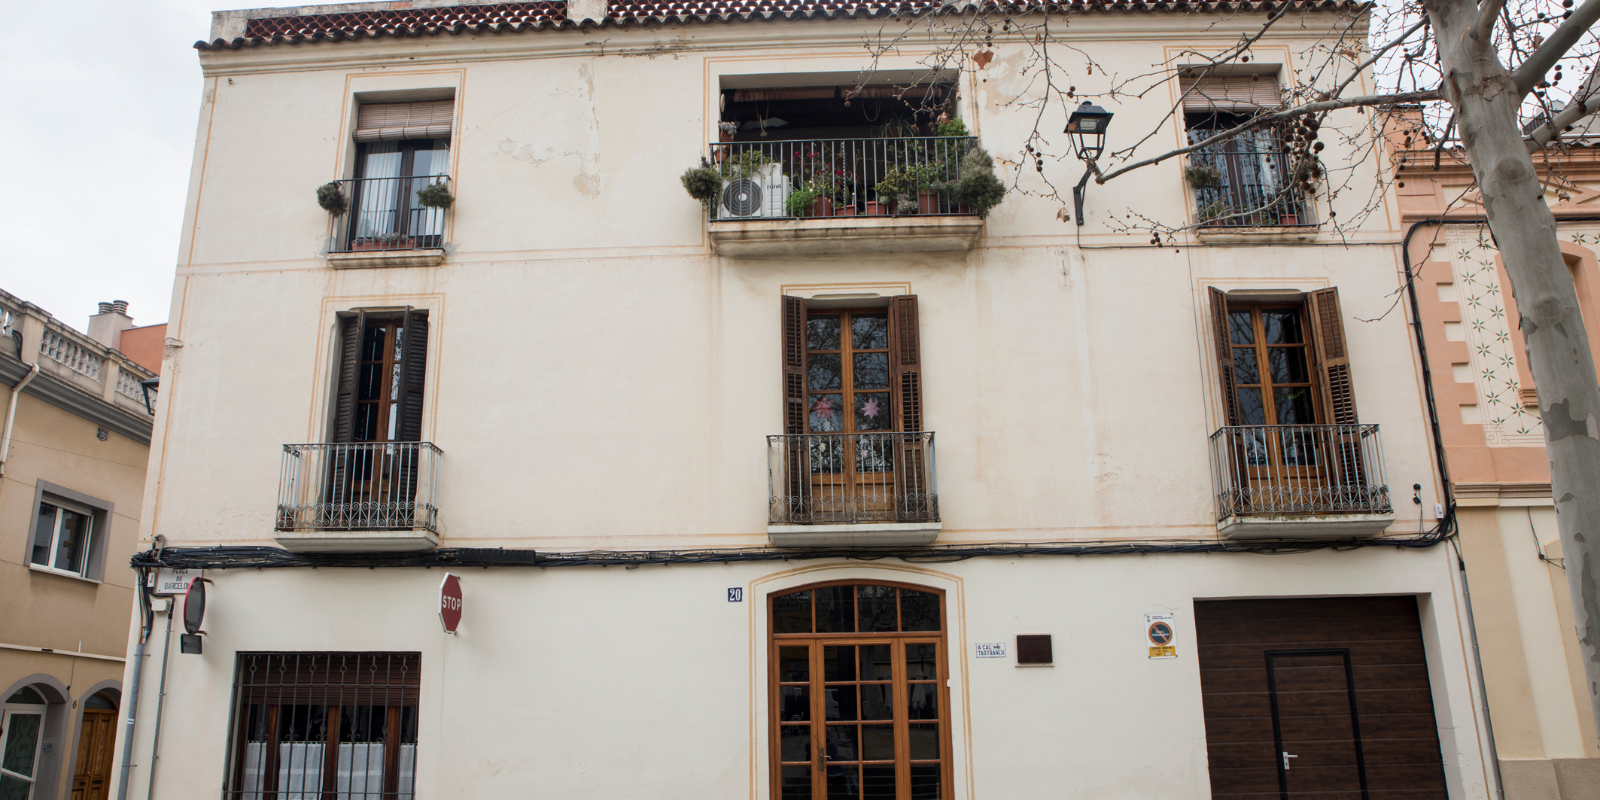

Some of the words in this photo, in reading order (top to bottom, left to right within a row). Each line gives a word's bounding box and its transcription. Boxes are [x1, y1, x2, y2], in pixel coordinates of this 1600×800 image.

[164, 582, 190, 590] BARCELO
[729, 588, 741, 601] 20
[442, 595, 461, 611] STOP
[72, 700, 77, 709] 6
